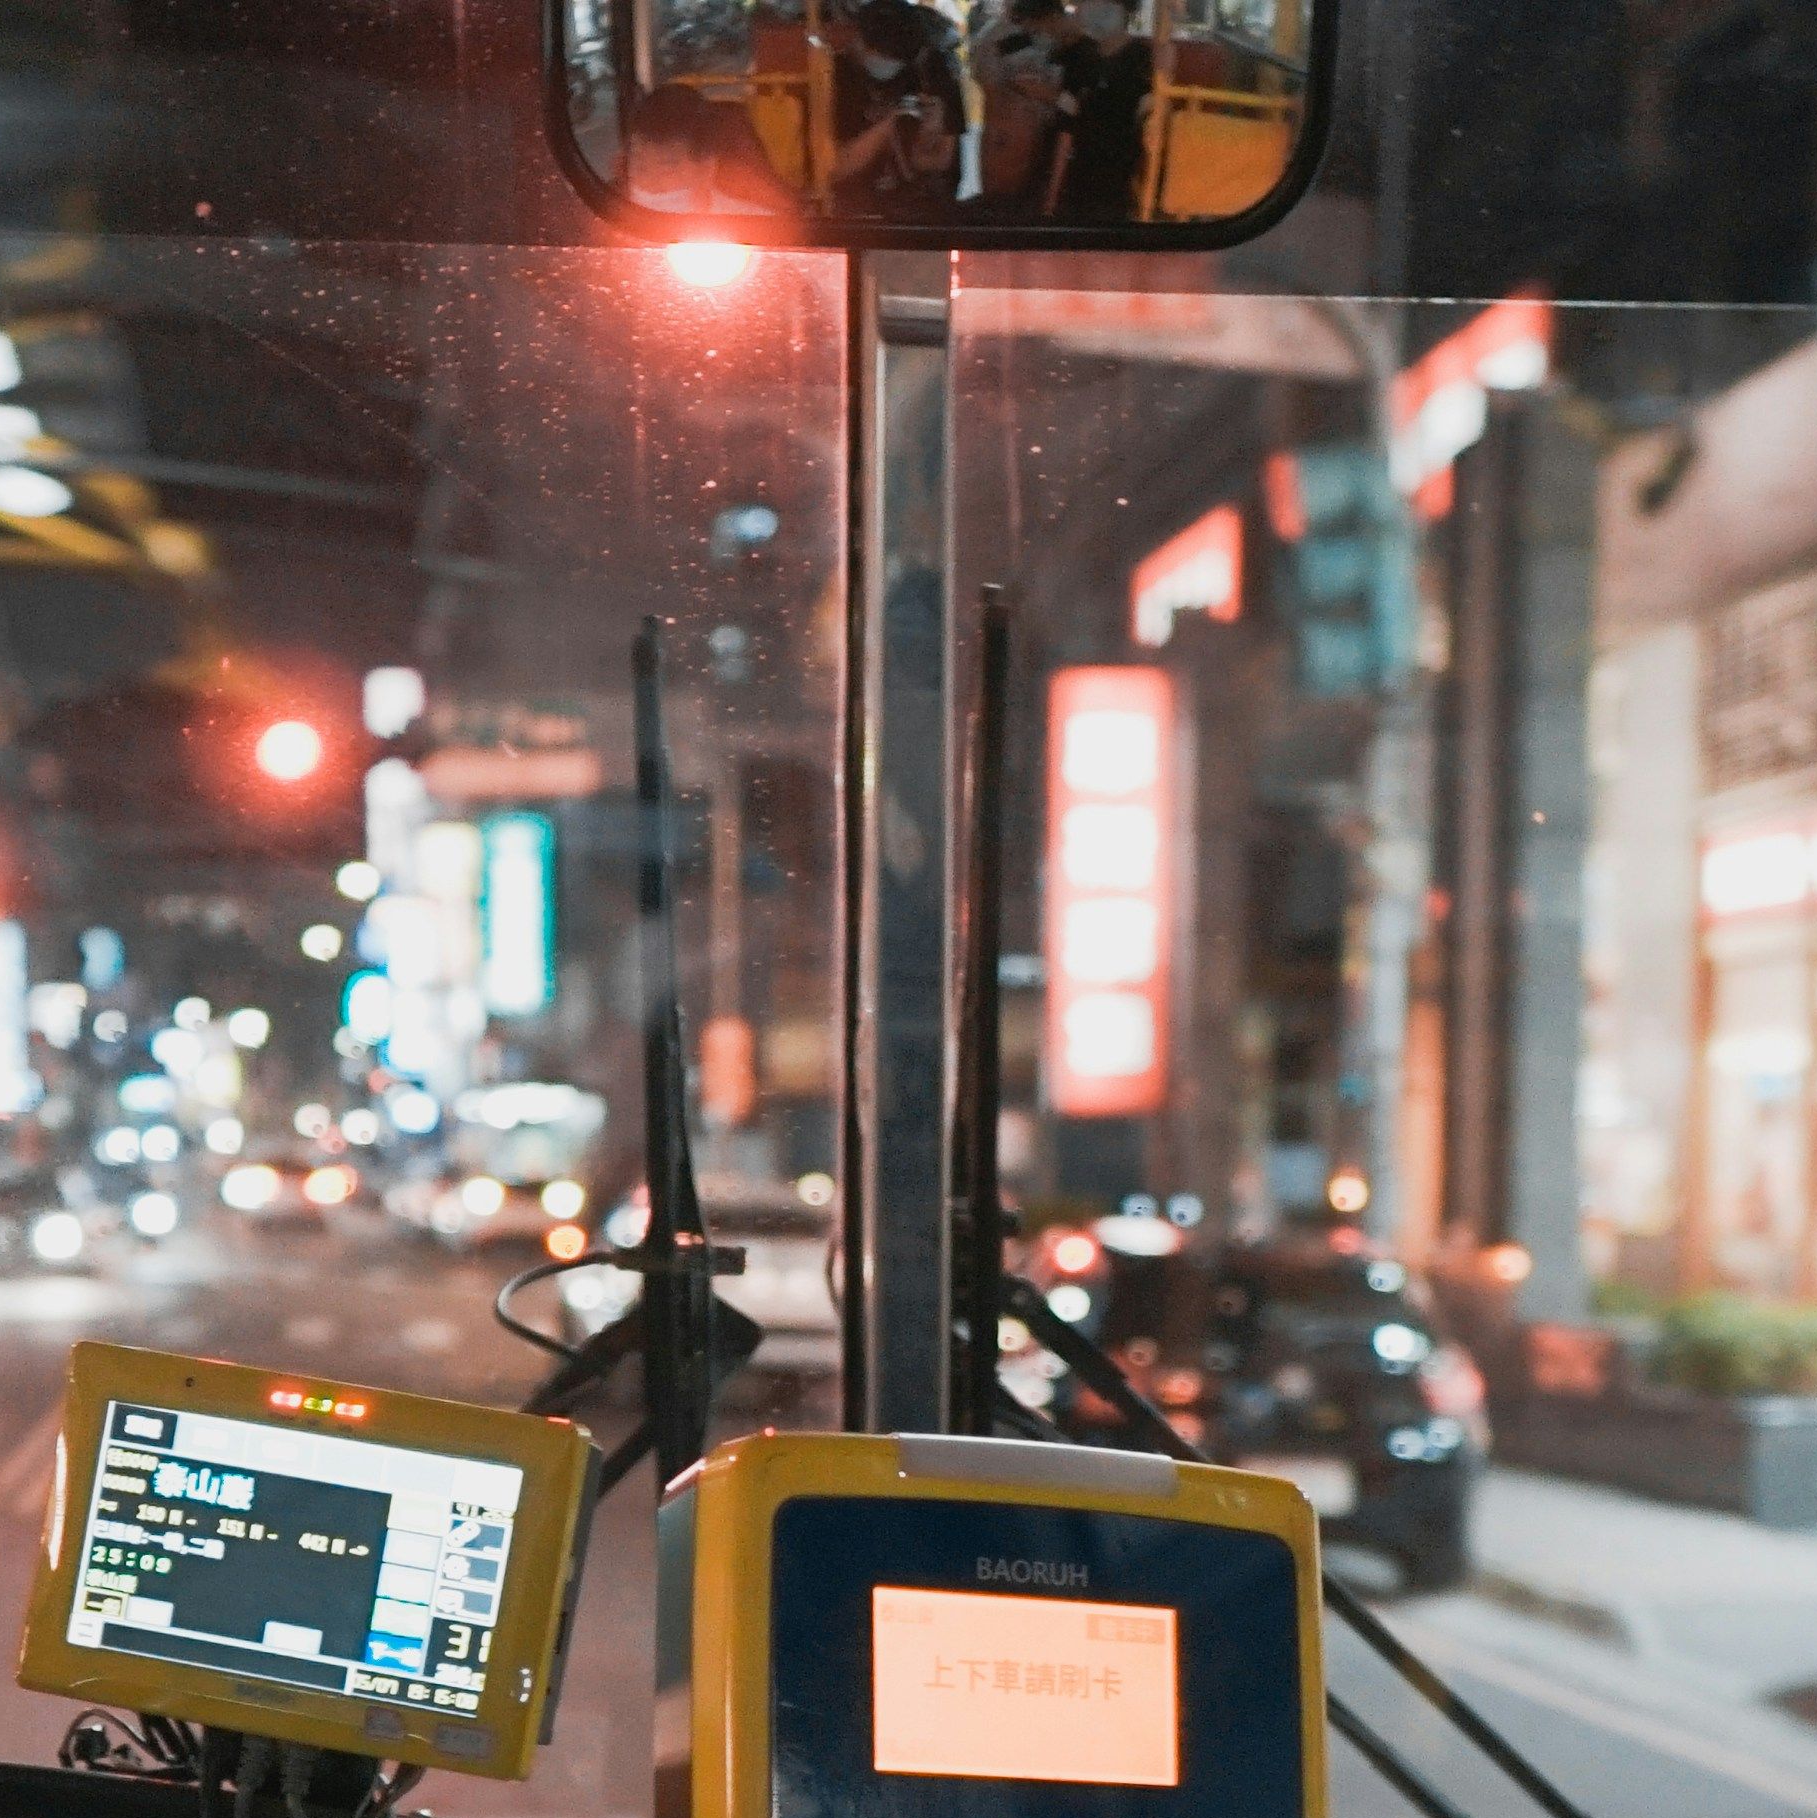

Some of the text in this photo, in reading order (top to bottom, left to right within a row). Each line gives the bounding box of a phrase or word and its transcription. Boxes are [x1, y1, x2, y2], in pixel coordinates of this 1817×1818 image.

[976, 1556, 1089, 1588] BAORUH
[923, 1655, 1122, 1701] 上下車請刷卡
